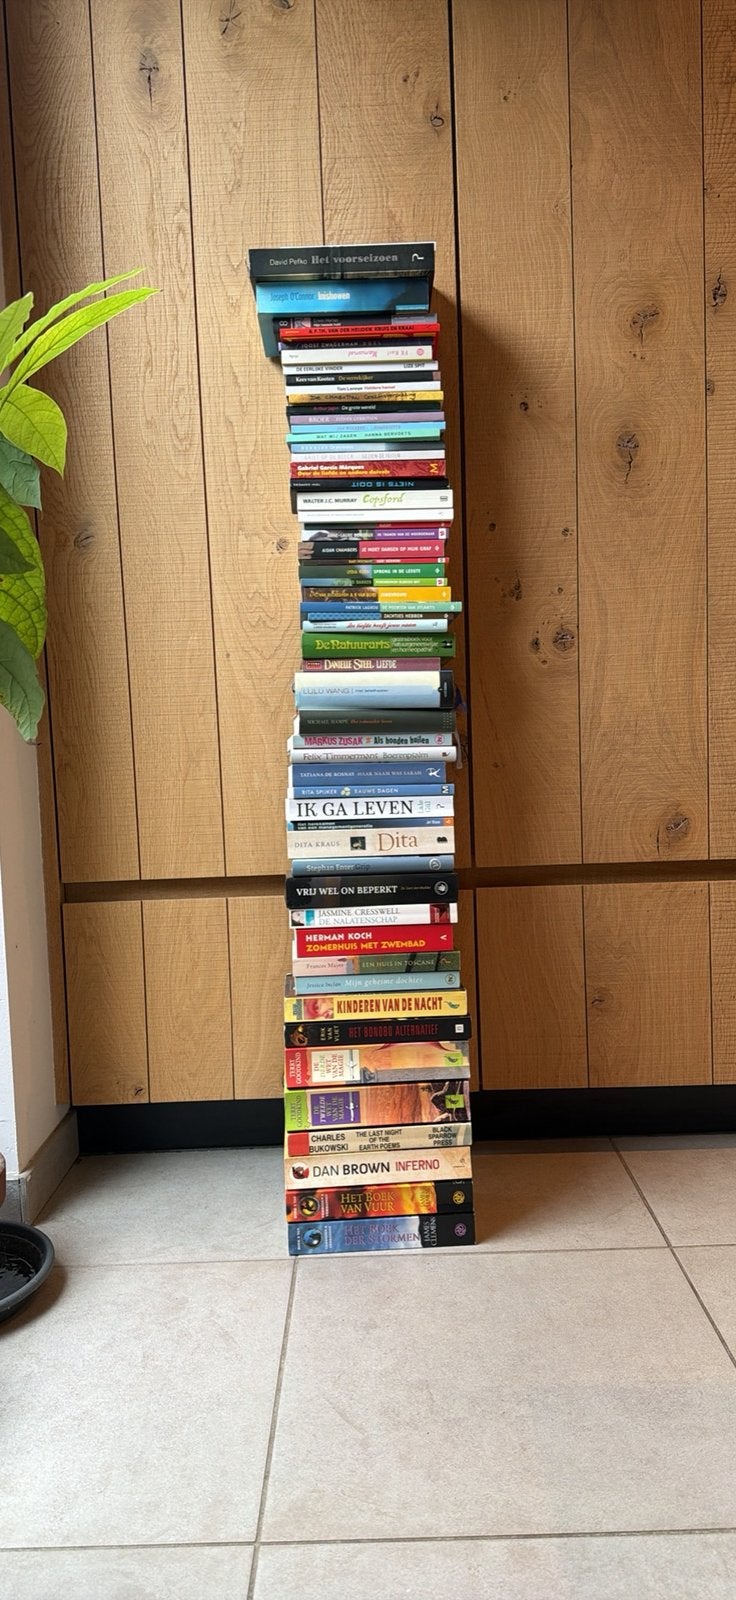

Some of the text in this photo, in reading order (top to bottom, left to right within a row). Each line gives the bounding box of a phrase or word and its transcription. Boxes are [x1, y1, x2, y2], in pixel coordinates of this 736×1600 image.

[270, 254, 398, 266] David Pefko Het voorseizoen
[318, 291, 350, 300] Inishowen
[363, 492, 405, 507] Copsford
[316, 639, 391, 650] De Natuurarts
[325, 659, 397, 670] DANIELLE LIEFDE
[304, 736, 429, 746] MARKUS ZUSAK Als honden huilen
[304, 751, 428, 761] Felix Timmermans Boerenpsalm
[297, 800, 413, 817] IK GA LEVEN
[378, 832, 418, 851] Dita
[306, 864, 334, 873] Stephan
[296, 888, 316, 896] VRIJ
[319, 887, 339, 895] WEL
[341, 887, 354, 895] ON
[357, 885, 398, 895] BEPERKT
[318, 907, 400, 918] JASMINE CRESSWELL
[333, 916, 397, 925] NALATENSCHAP
[305, 932, 373, 942] HERMAN KOCH
[306, 940, 426, 952] ZOMERHUIS MET ZWEMBAD
[345, 978, 363, 988] Mijn
[364, 978, 395, 988] geheime
[337, 997, 442, 1014] KINDEREN VAN DE NACHT
[349, 1024, 439, 1038] HET BONOBO ALTERNATIEF
[331, 1054, 338, 1063] DE
[314, 1062, 319, 1072] DE
[313, 1105, 319, 1115] DE
[311, 1134, 345, 1143] CHARLES
[309, 1144, 348, 1153] BUKOWSKI
[313, 1159, 440, 1177] DAN BROWN INFERNO
[341, 1192, 394, 1204] HET BOEK
[341, 1202, 394, 1213] VAN VUUR
[345, 1223, 398, 1235] HET BOEK
[345, 1235, 366, 1245] DER
[368, 1233, 421, 1244] STORMEN
